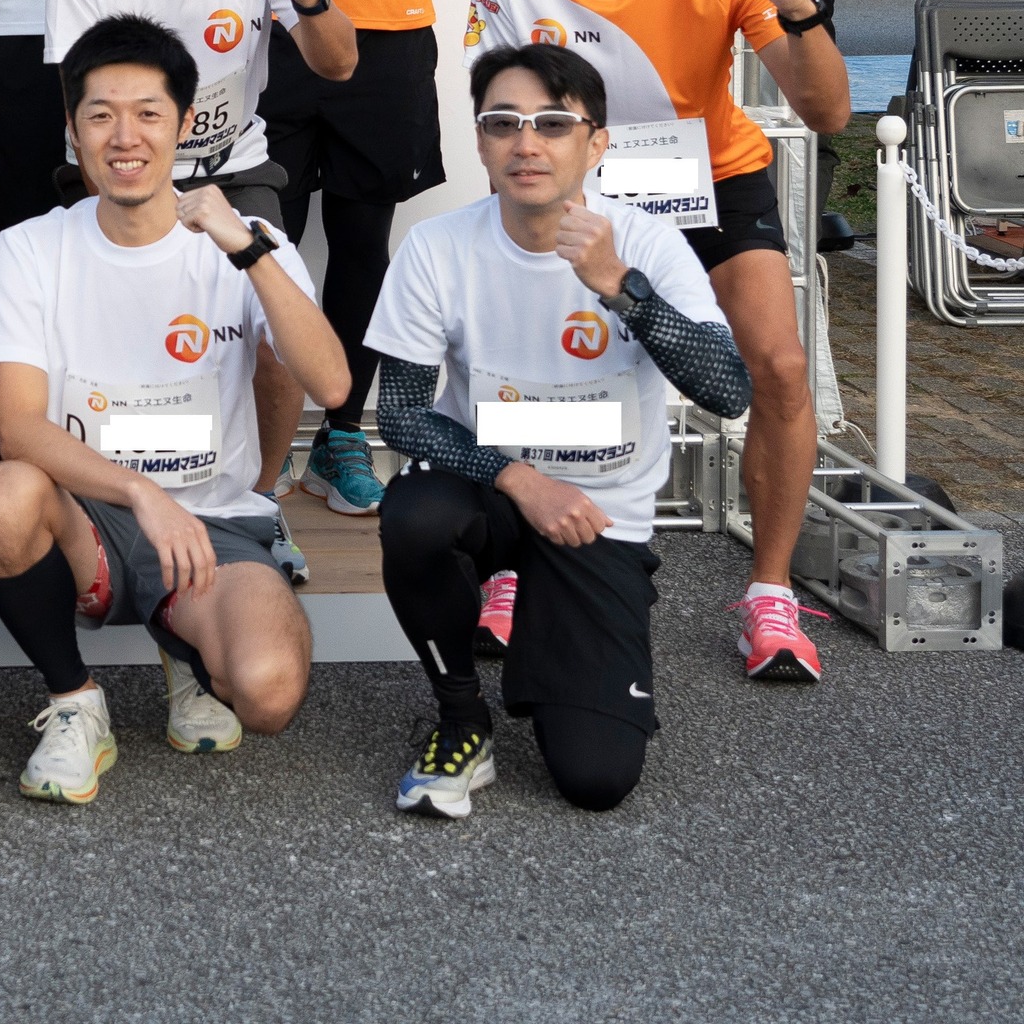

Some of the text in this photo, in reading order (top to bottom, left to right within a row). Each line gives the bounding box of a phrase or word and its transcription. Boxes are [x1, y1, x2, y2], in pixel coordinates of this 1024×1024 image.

[575, 31, 601, 44] NN
[191, 101, 229, 136] 85
[623, 135, 679, 149] エヌエヌ生命
[212, 324, 243, 344] NN
[133, 392, 192, 408] エヌエヌ生命
[523, 394, 540, 402] NN
[520, 441, 636, 463] 第37回 NAHAマラソン
[141, 450, 217, 473] NAHAマラソン
